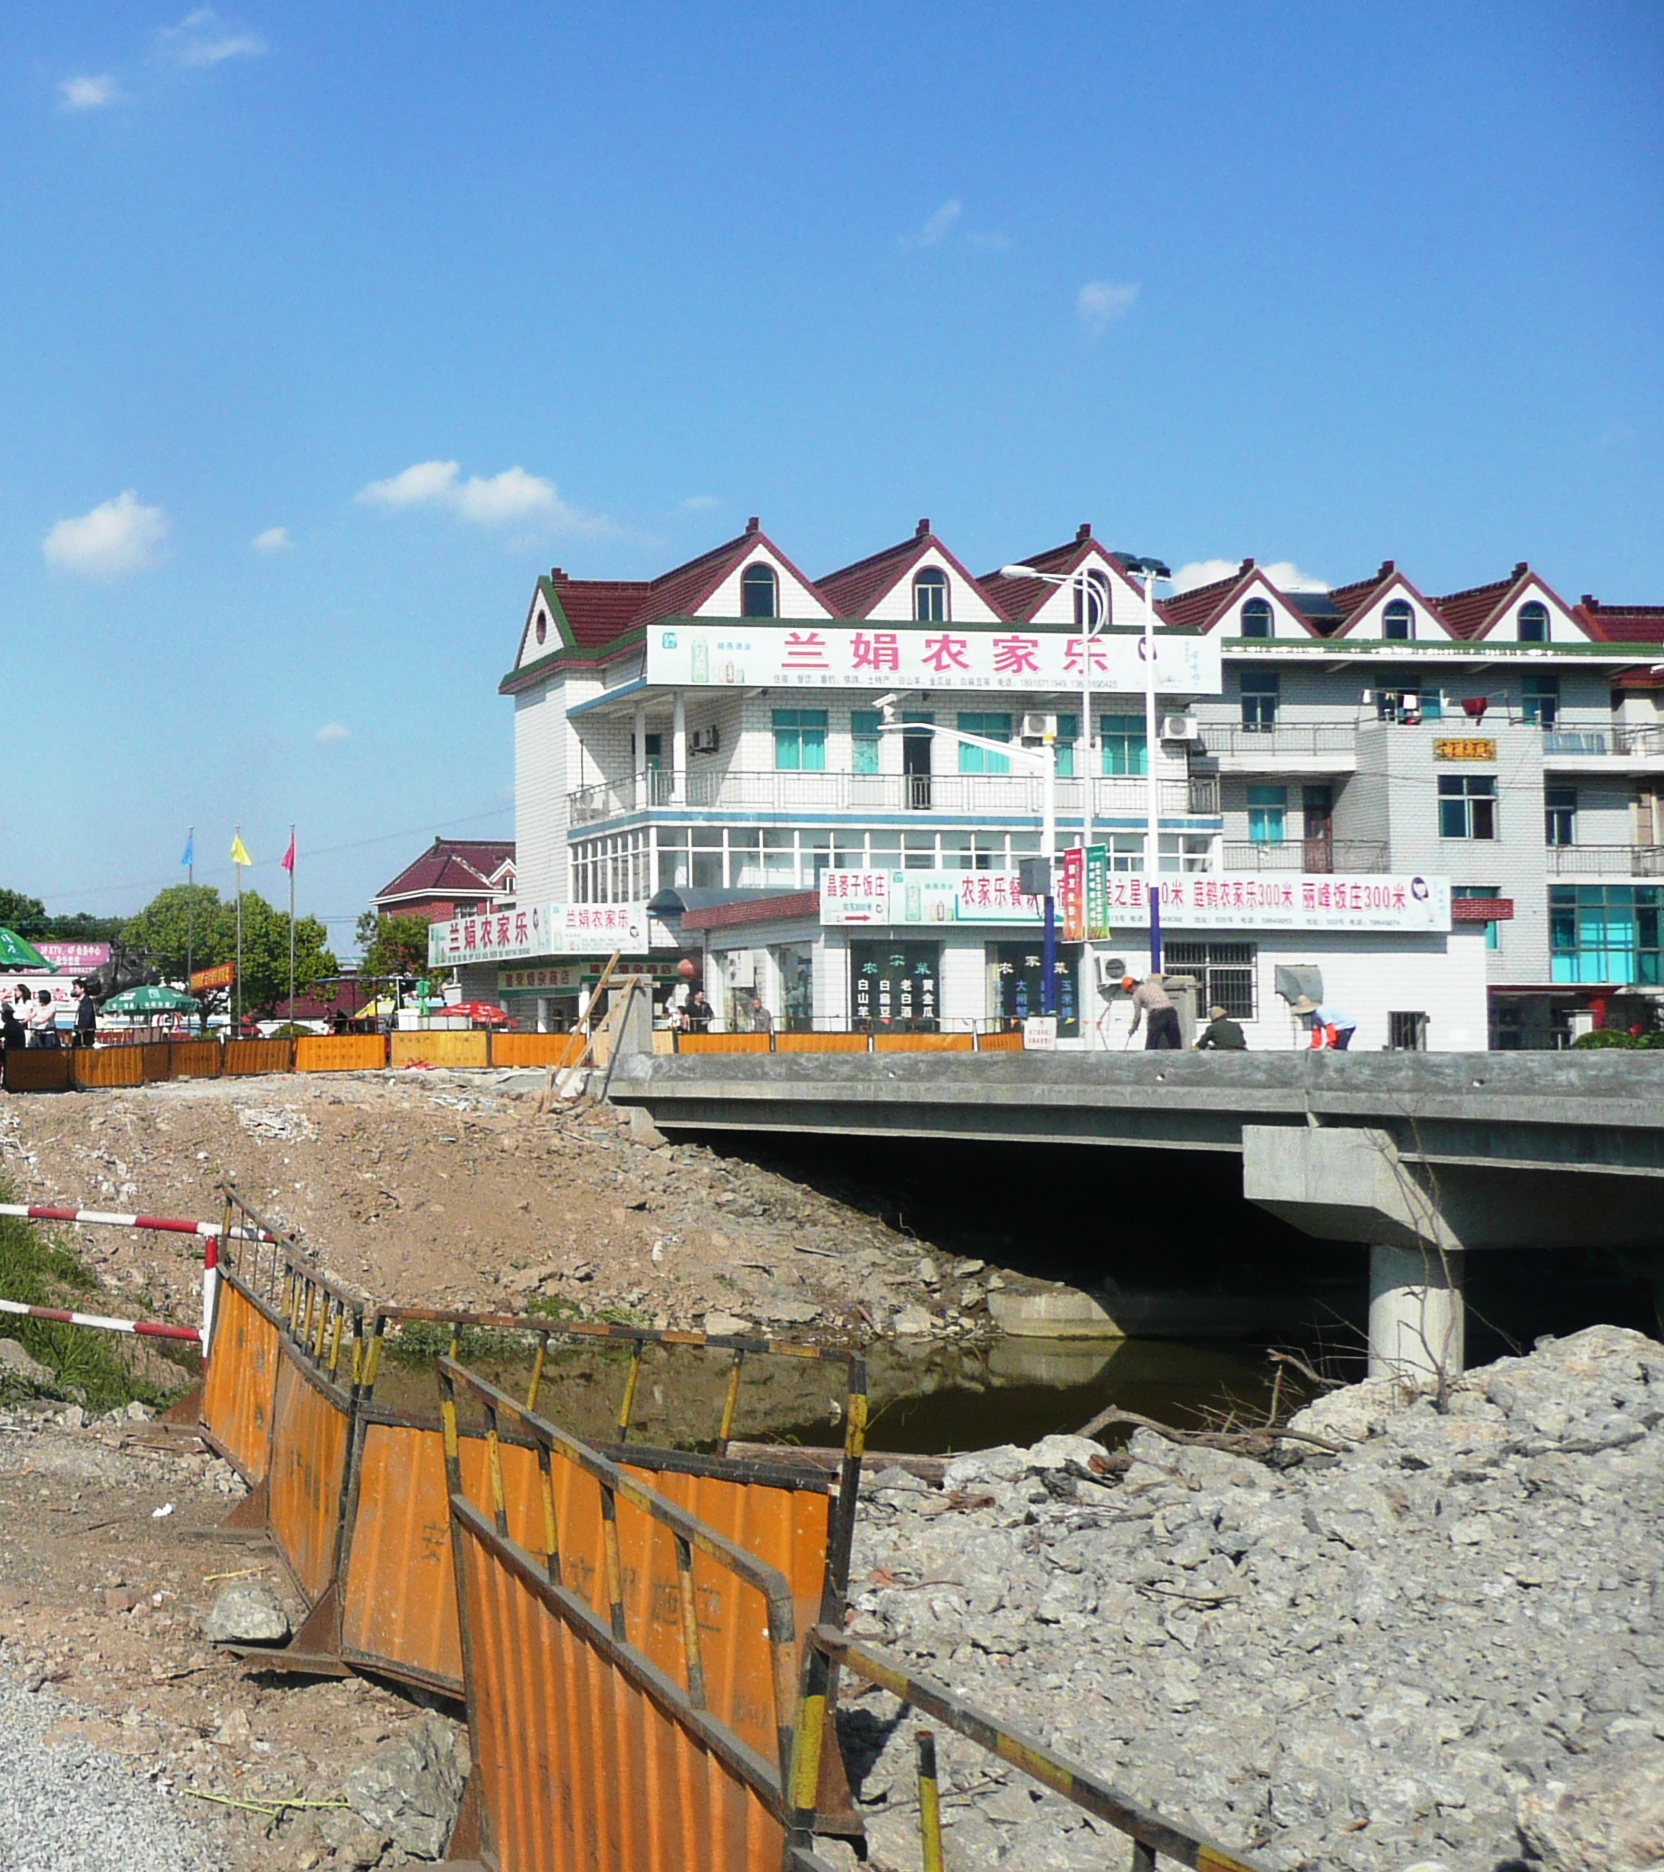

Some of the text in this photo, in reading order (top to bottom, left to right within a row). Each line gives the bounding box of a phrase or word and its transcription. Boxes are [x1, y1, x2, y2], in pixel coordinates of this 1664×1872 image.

[780, 632, 1112, 676] 兰娟农家乐
[1302, 882, 1407, 911] 丽峰饭庄300米
[447, 911, 529, 953] 兰娟农家乐
[565, 908, 631, 929] 兰娟农家乐
[857, 978, 870, 1018] 白山羊
